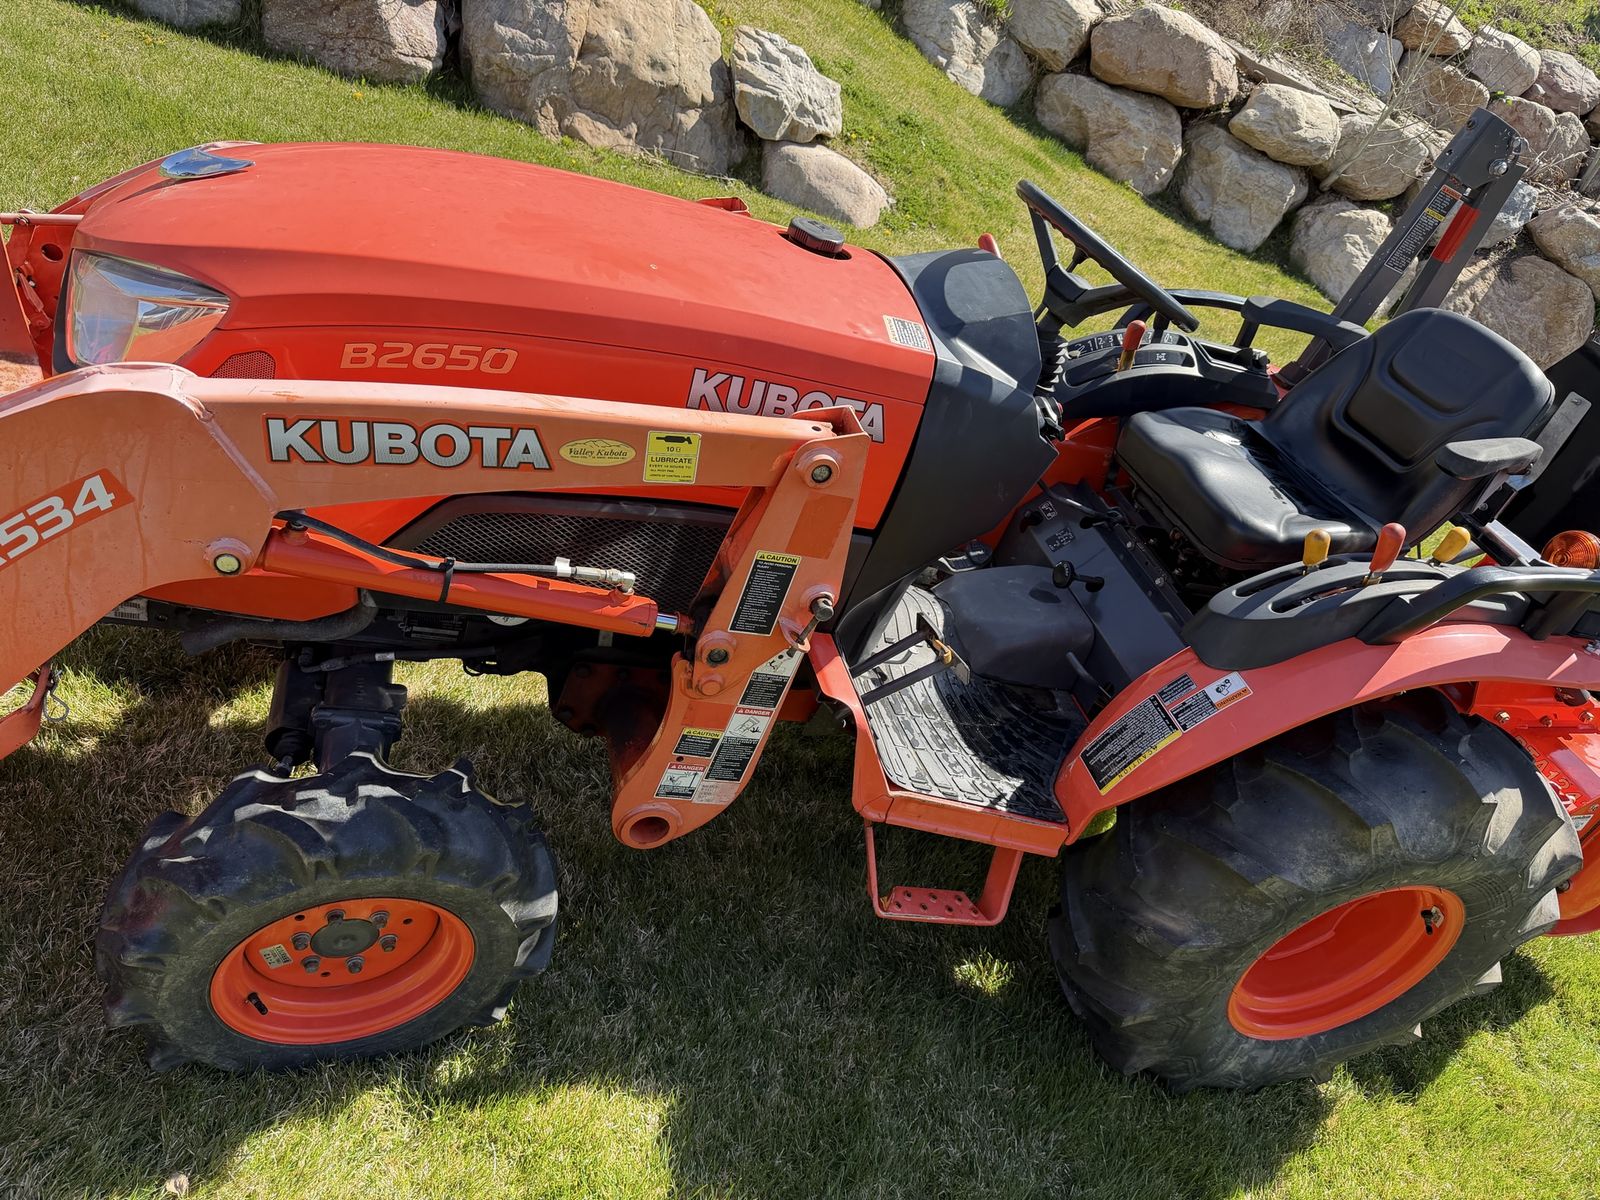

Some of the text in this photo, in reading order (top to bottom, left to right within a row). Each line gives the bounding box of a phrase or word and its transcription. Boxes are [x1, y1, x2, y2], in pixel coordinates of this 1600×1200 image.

[340, 342, 518, 374] B2650
[266, 418, 552, 470] KUBOTA
[568, 448, 628, 457] Valley Kubota
[650, 456, 693, 464] LUBRICATE
[0, 475, 115, 566] 534
[766, 554, 797, 564] CAUTION
[1216, 692, 1243, 708] WARNING
[744, 708, 771, 716] DANGER
[692, 730, 720, 738] CAUTION
[1118, 749, 1154, 779] CAUTION
